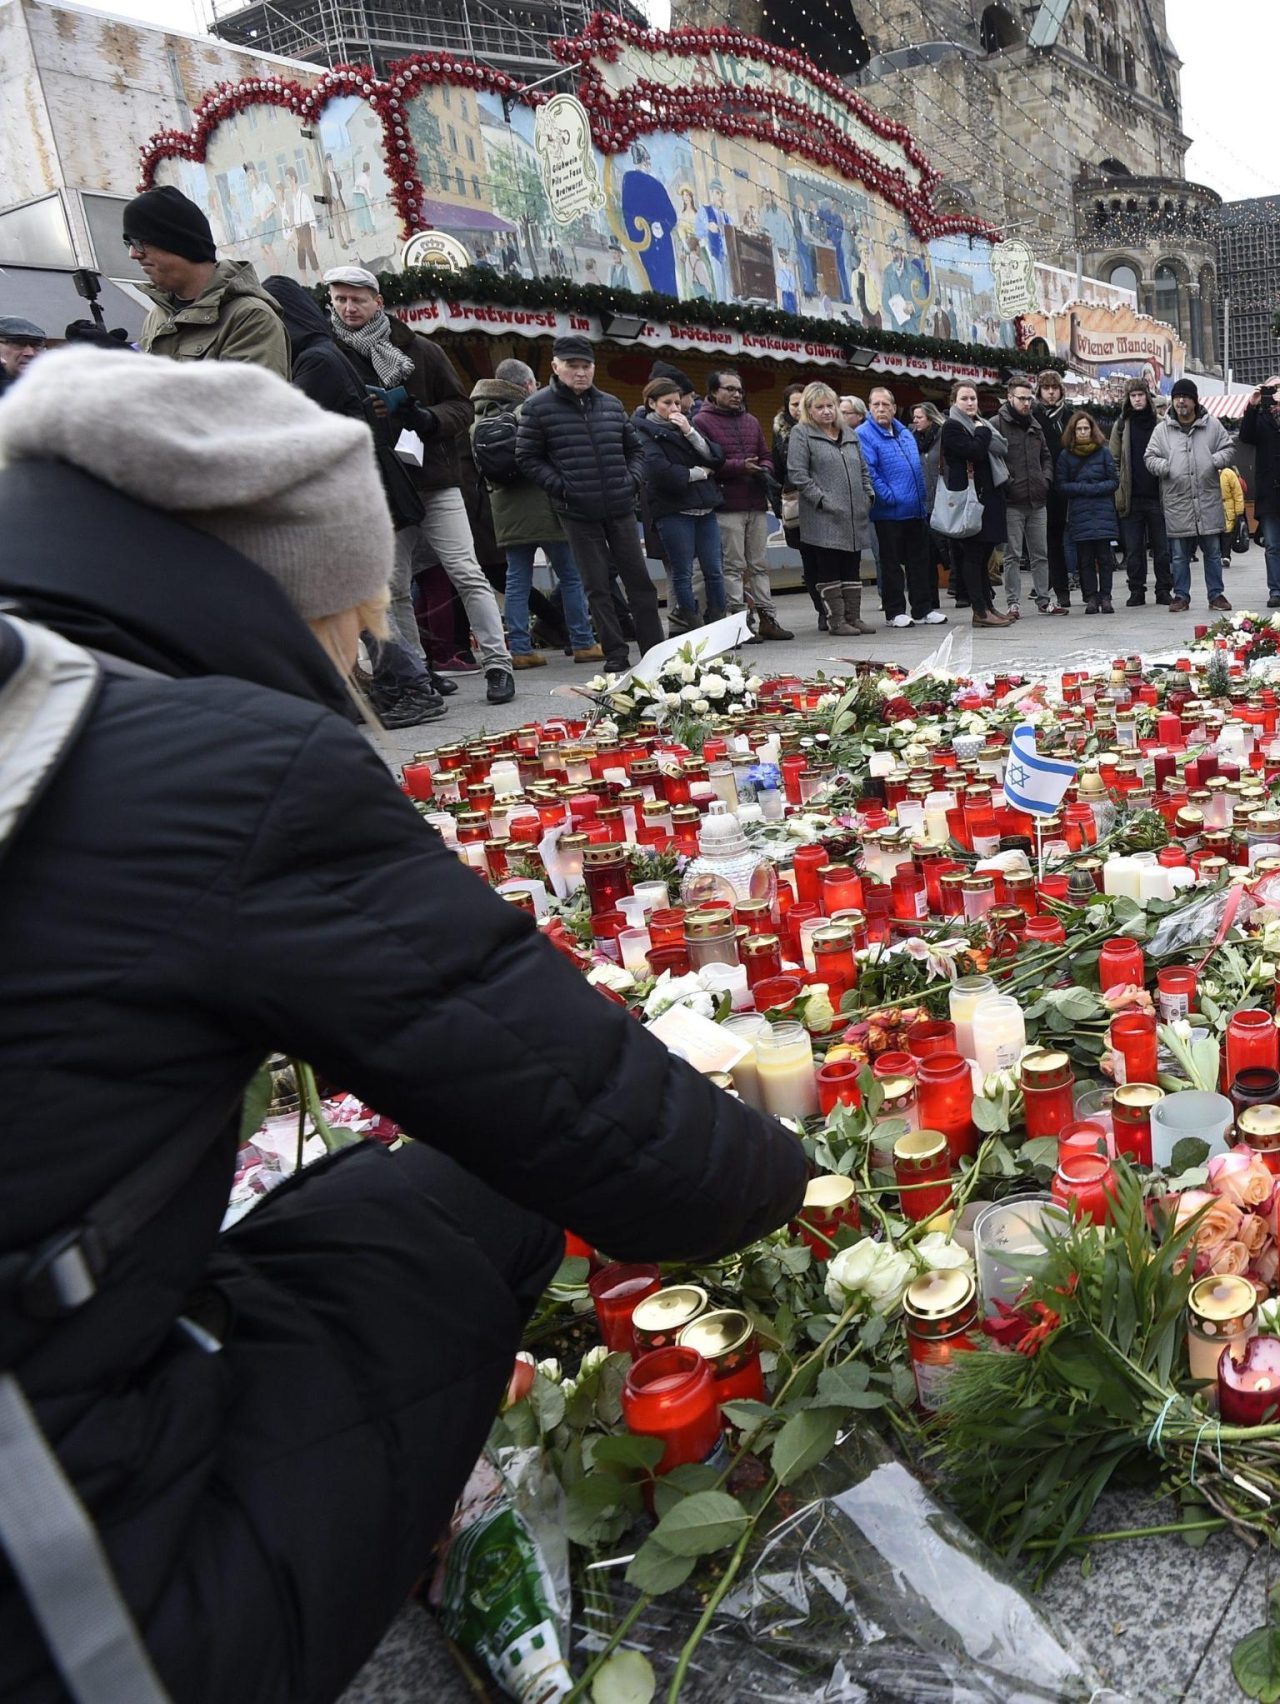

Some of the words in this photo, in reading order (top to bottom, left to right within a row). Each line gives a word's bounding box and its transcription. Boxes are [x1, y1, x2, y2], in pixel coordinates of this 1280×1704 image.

[449, 302, 557, 328] Bratwurst
[669, 324, 732, 345] Brötchen
[742, 335, 801, 353] Krakauer
[804, 342, 847, 361] Glühwe
[884, 355, 903, 367] vom
[906, 358, 928, 370] Fass
[1076, 335, 1115, 356] Wiener
[1116, 336, 1162, 358] Mandeln
